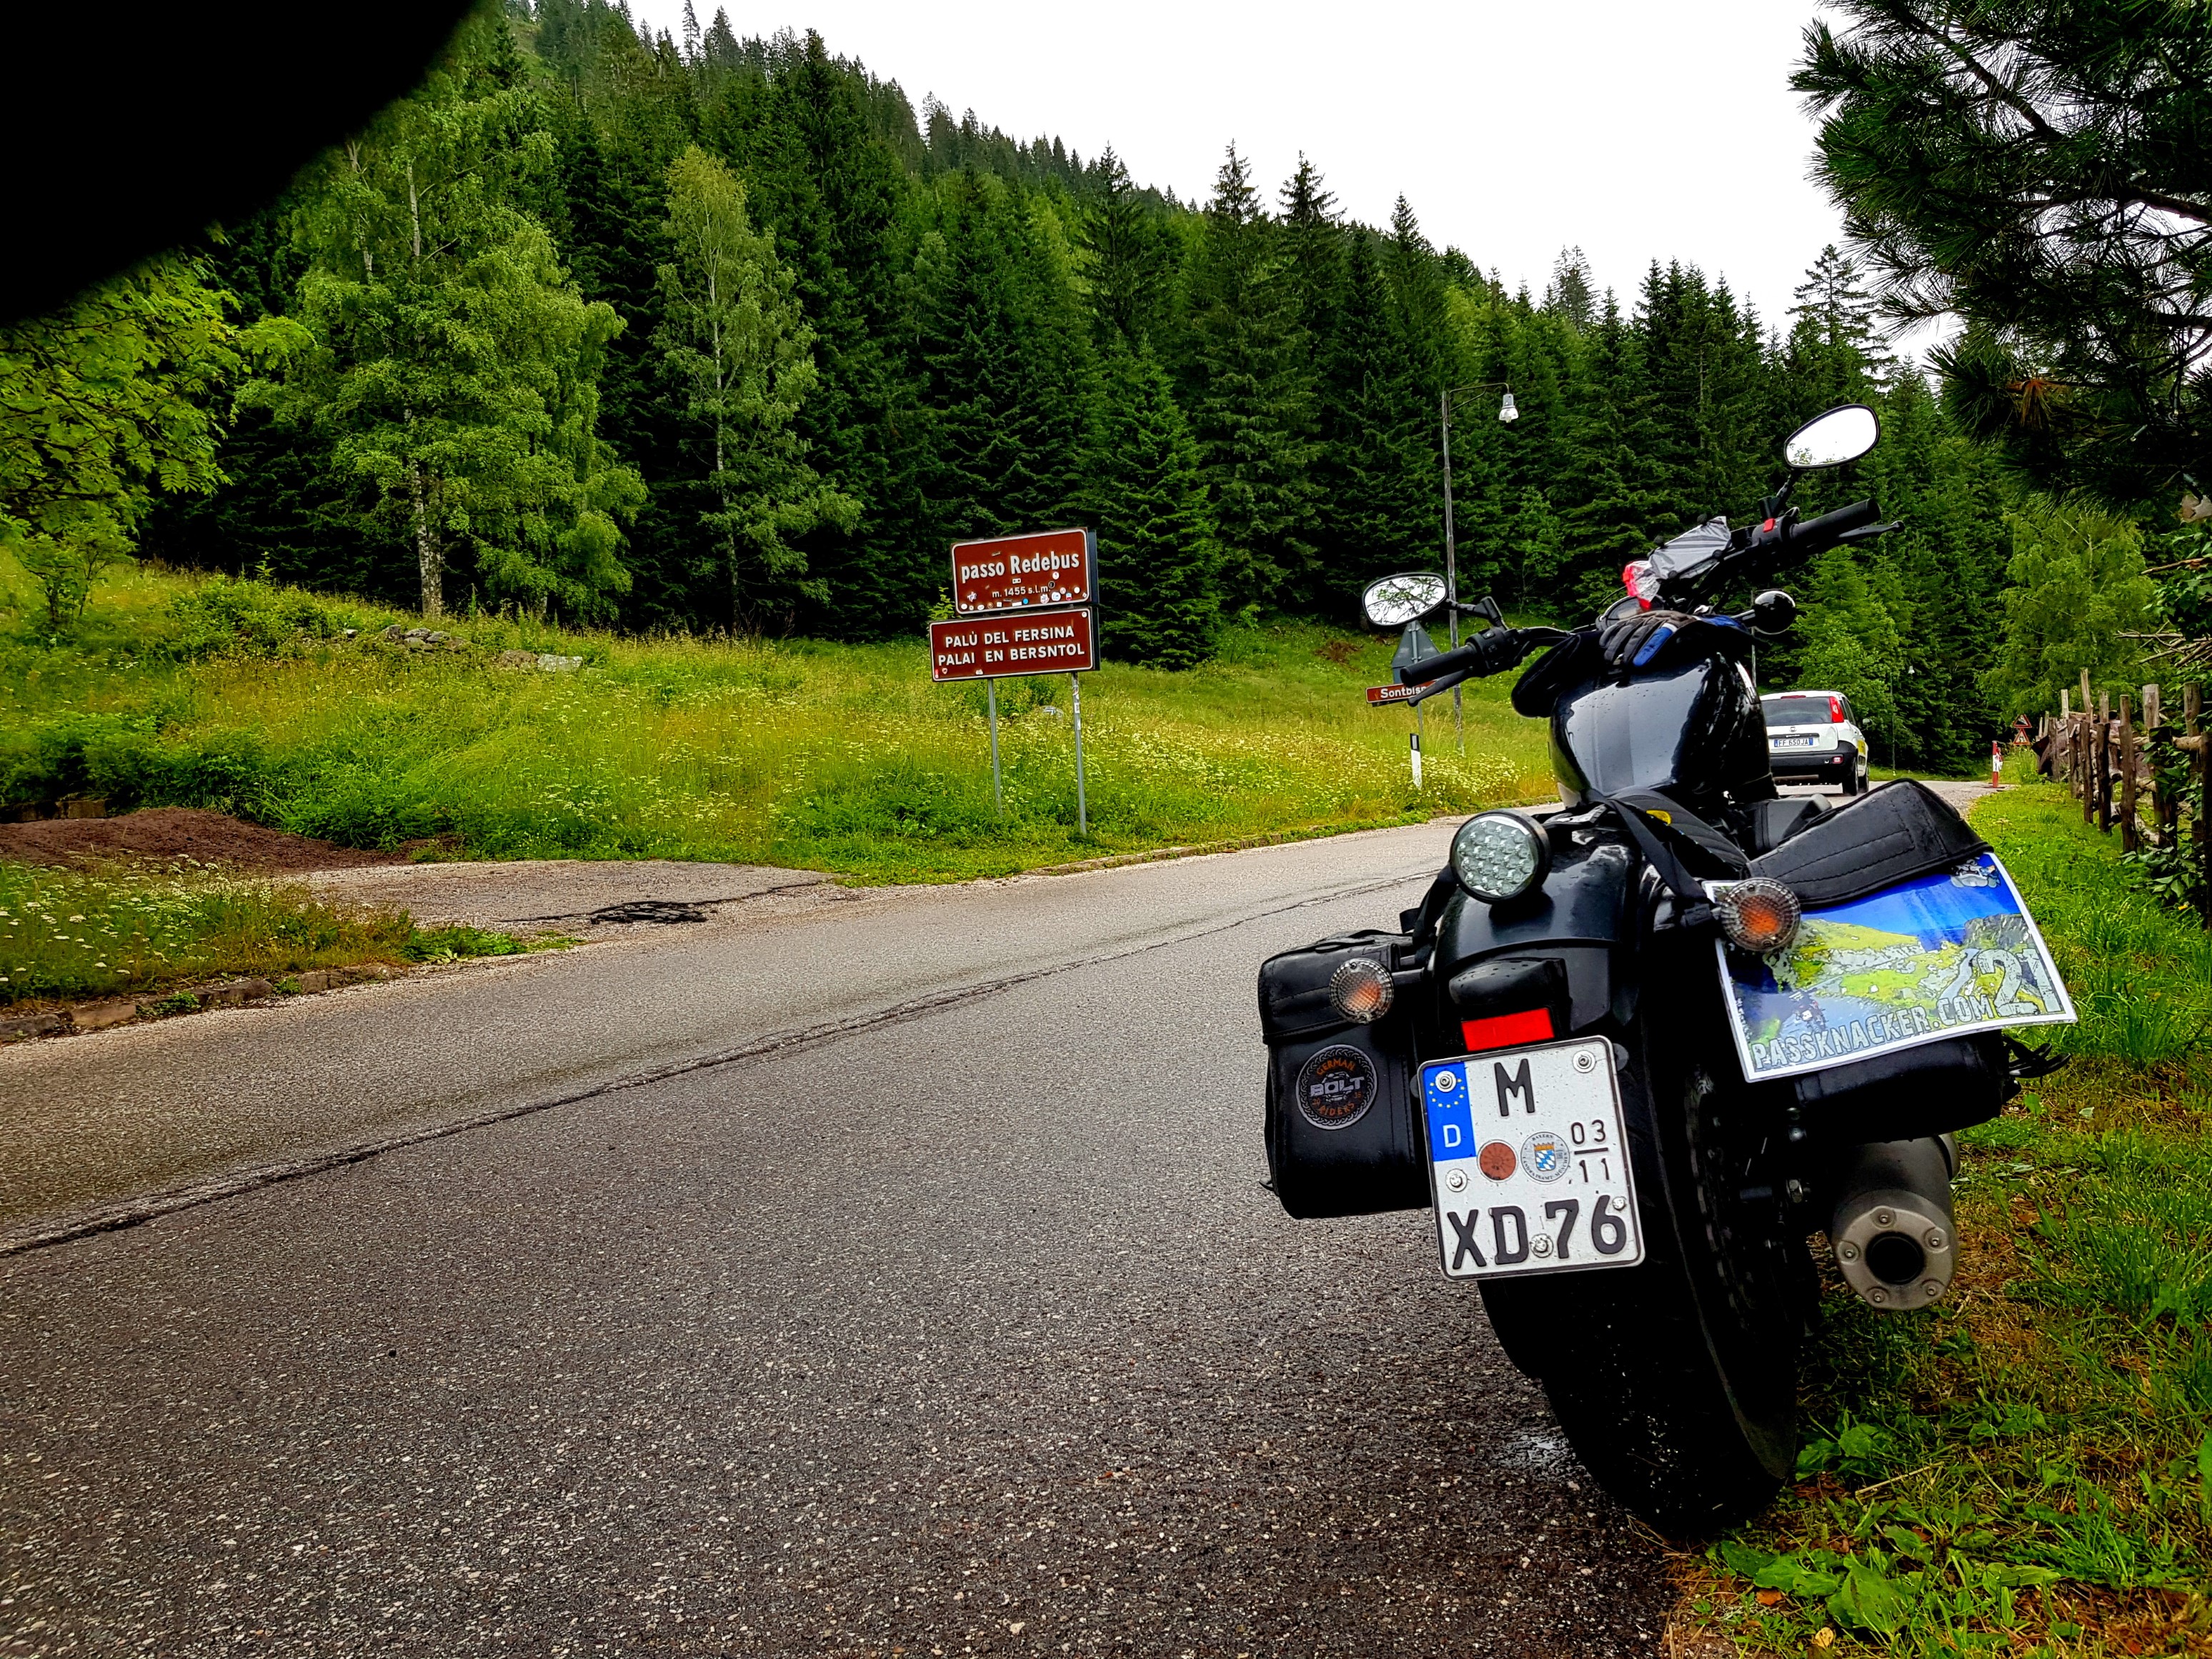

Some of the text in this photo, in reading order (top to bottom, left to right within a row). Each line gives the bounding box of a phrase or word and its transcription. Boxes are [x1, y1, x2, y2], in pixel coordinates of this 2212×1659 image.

[961, 551, 1080, 583] passo Redebus
[1004, 586, 1026, 597] 1455
[1027, 584, 1051, 594] s.l.m.
[985, 631, 1009, 644] DEL
[1015, 625, 1075, 642] FERSINA
[938, 643, 1085, 667] PALAI EN BERSNTOL
[1753, 947, 2063, 1070] PASSKNACKER.COM 21
[1317, 1057, 1355, 1075] GERMAN
[1310, 1076, 1365, 1097] BOLT
[1493, 1058, 1535, 1117] M
[1443, 1124, 1461, 1147] D
[1571, 1120, 1606, 1145] 03
[1579, 1158, 1610, 1183] 11
[1447, 1195, 1627, 1270] XD 76
